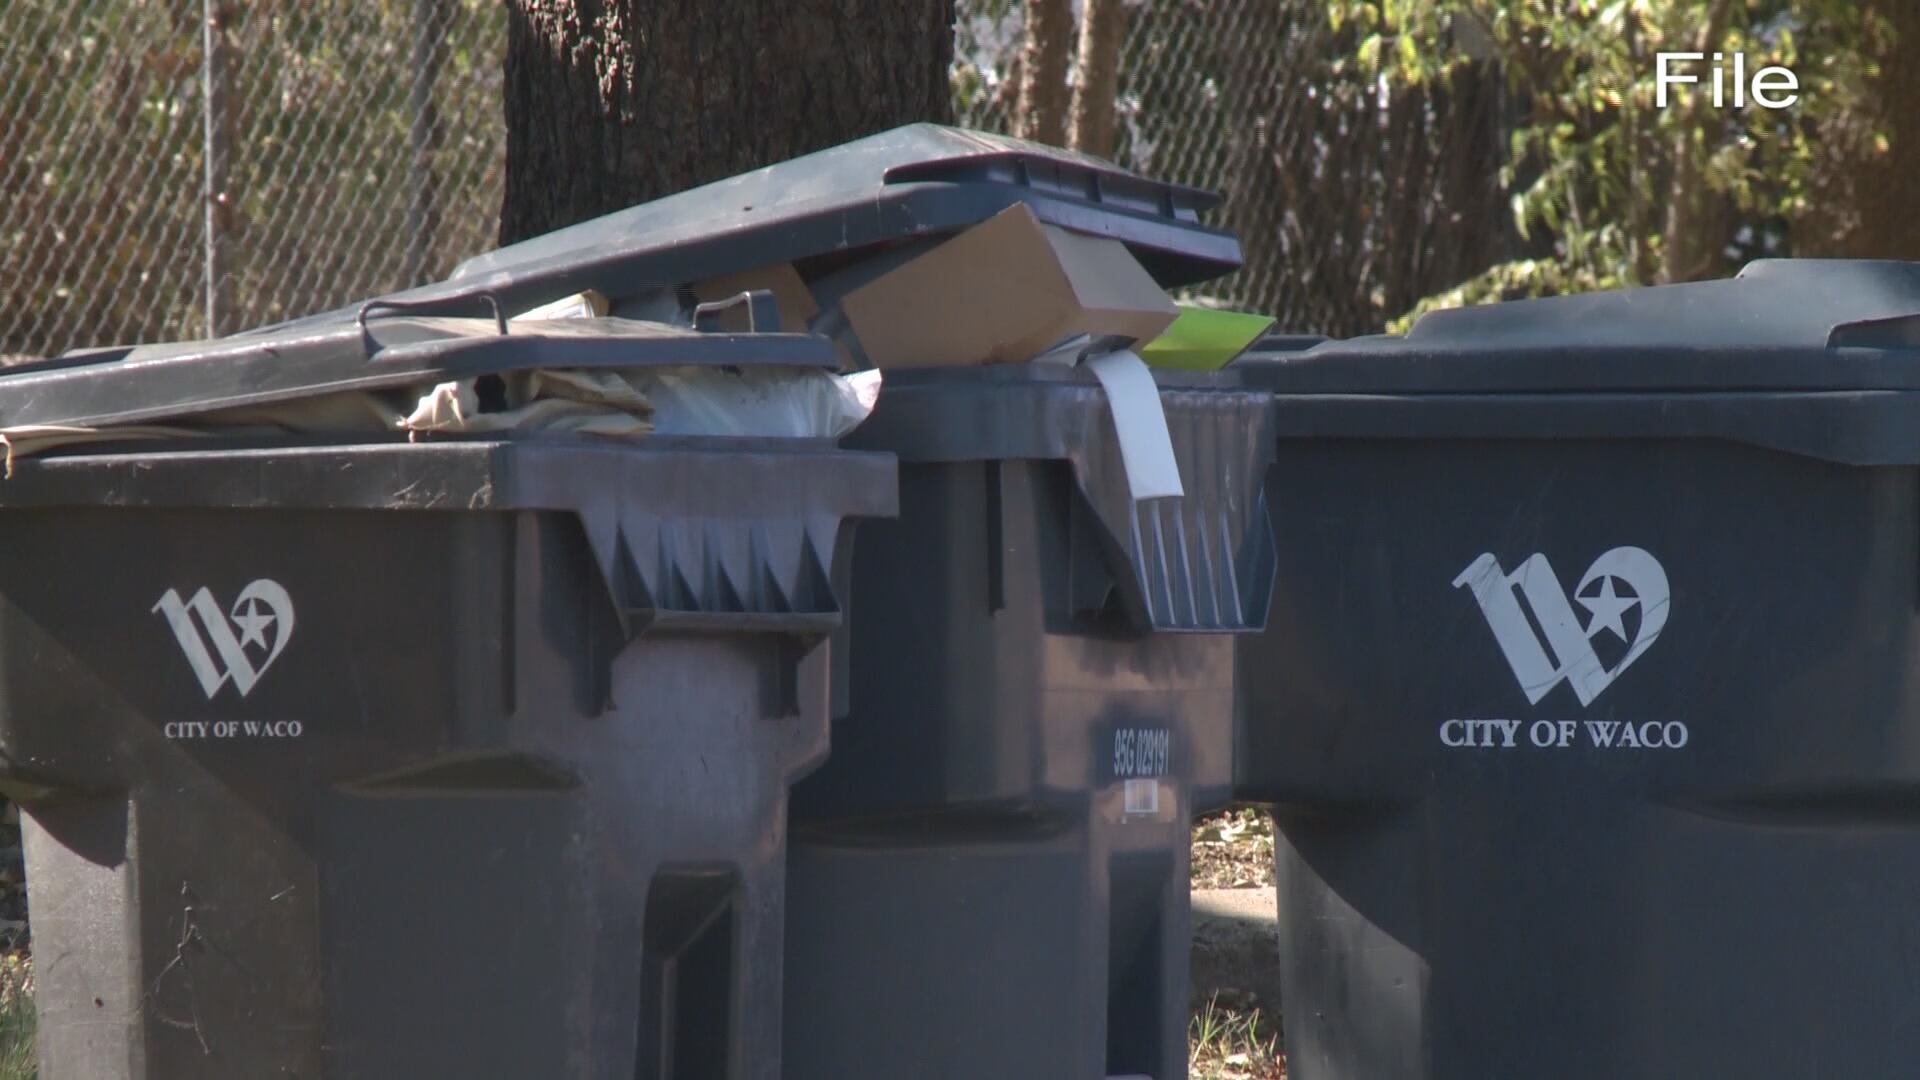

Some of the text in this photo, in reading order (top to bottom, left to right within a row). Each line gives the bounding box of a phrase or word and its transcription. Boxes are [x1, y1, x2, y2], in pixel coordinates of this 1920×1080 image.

[164, 720, 303, 739] CITY OF WACO
[1439, 719, 1688, 748] CITY OF WACO
[1114, 728, 1135, 776] 95G
